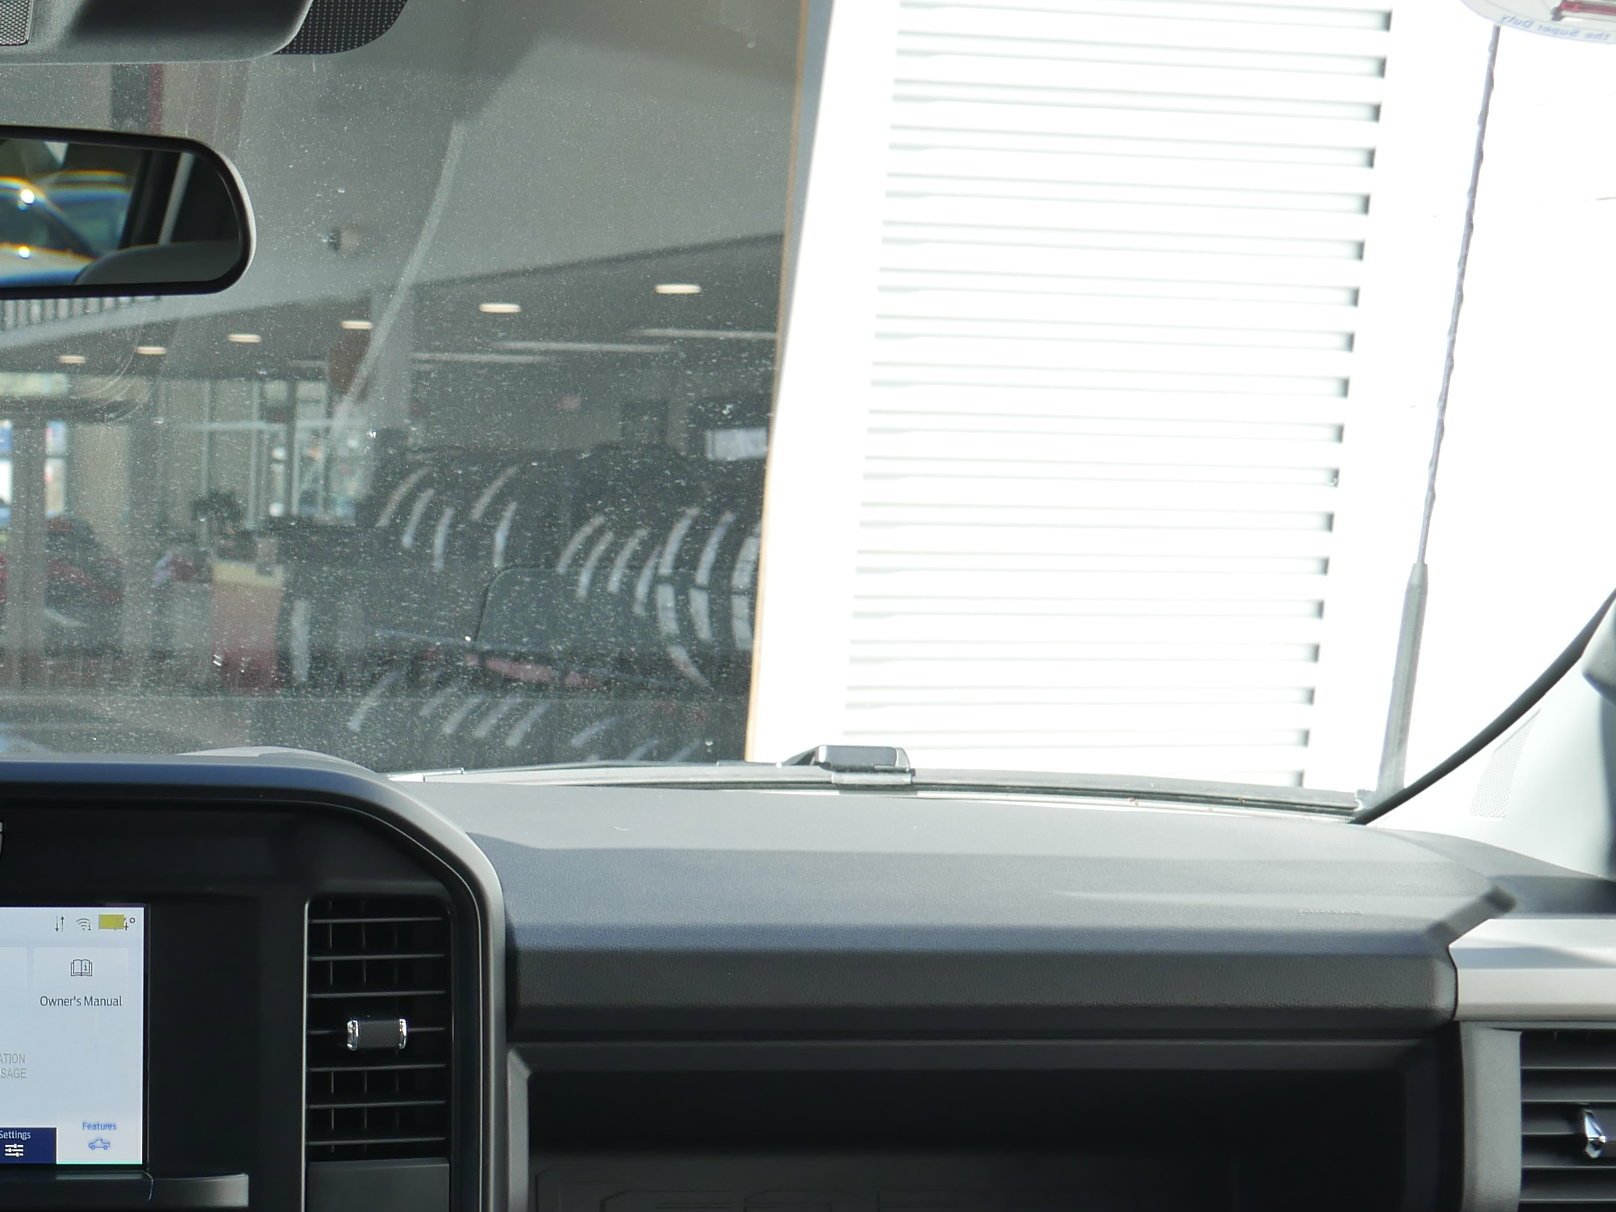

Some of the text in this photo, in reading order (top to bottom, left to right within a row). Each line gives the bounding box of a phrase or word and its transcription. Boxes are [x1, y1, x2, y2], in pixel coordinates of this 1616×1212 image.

[40, 995, 123, 1007] Owner's Manual
[82, 1122, 117, 1131] Features
